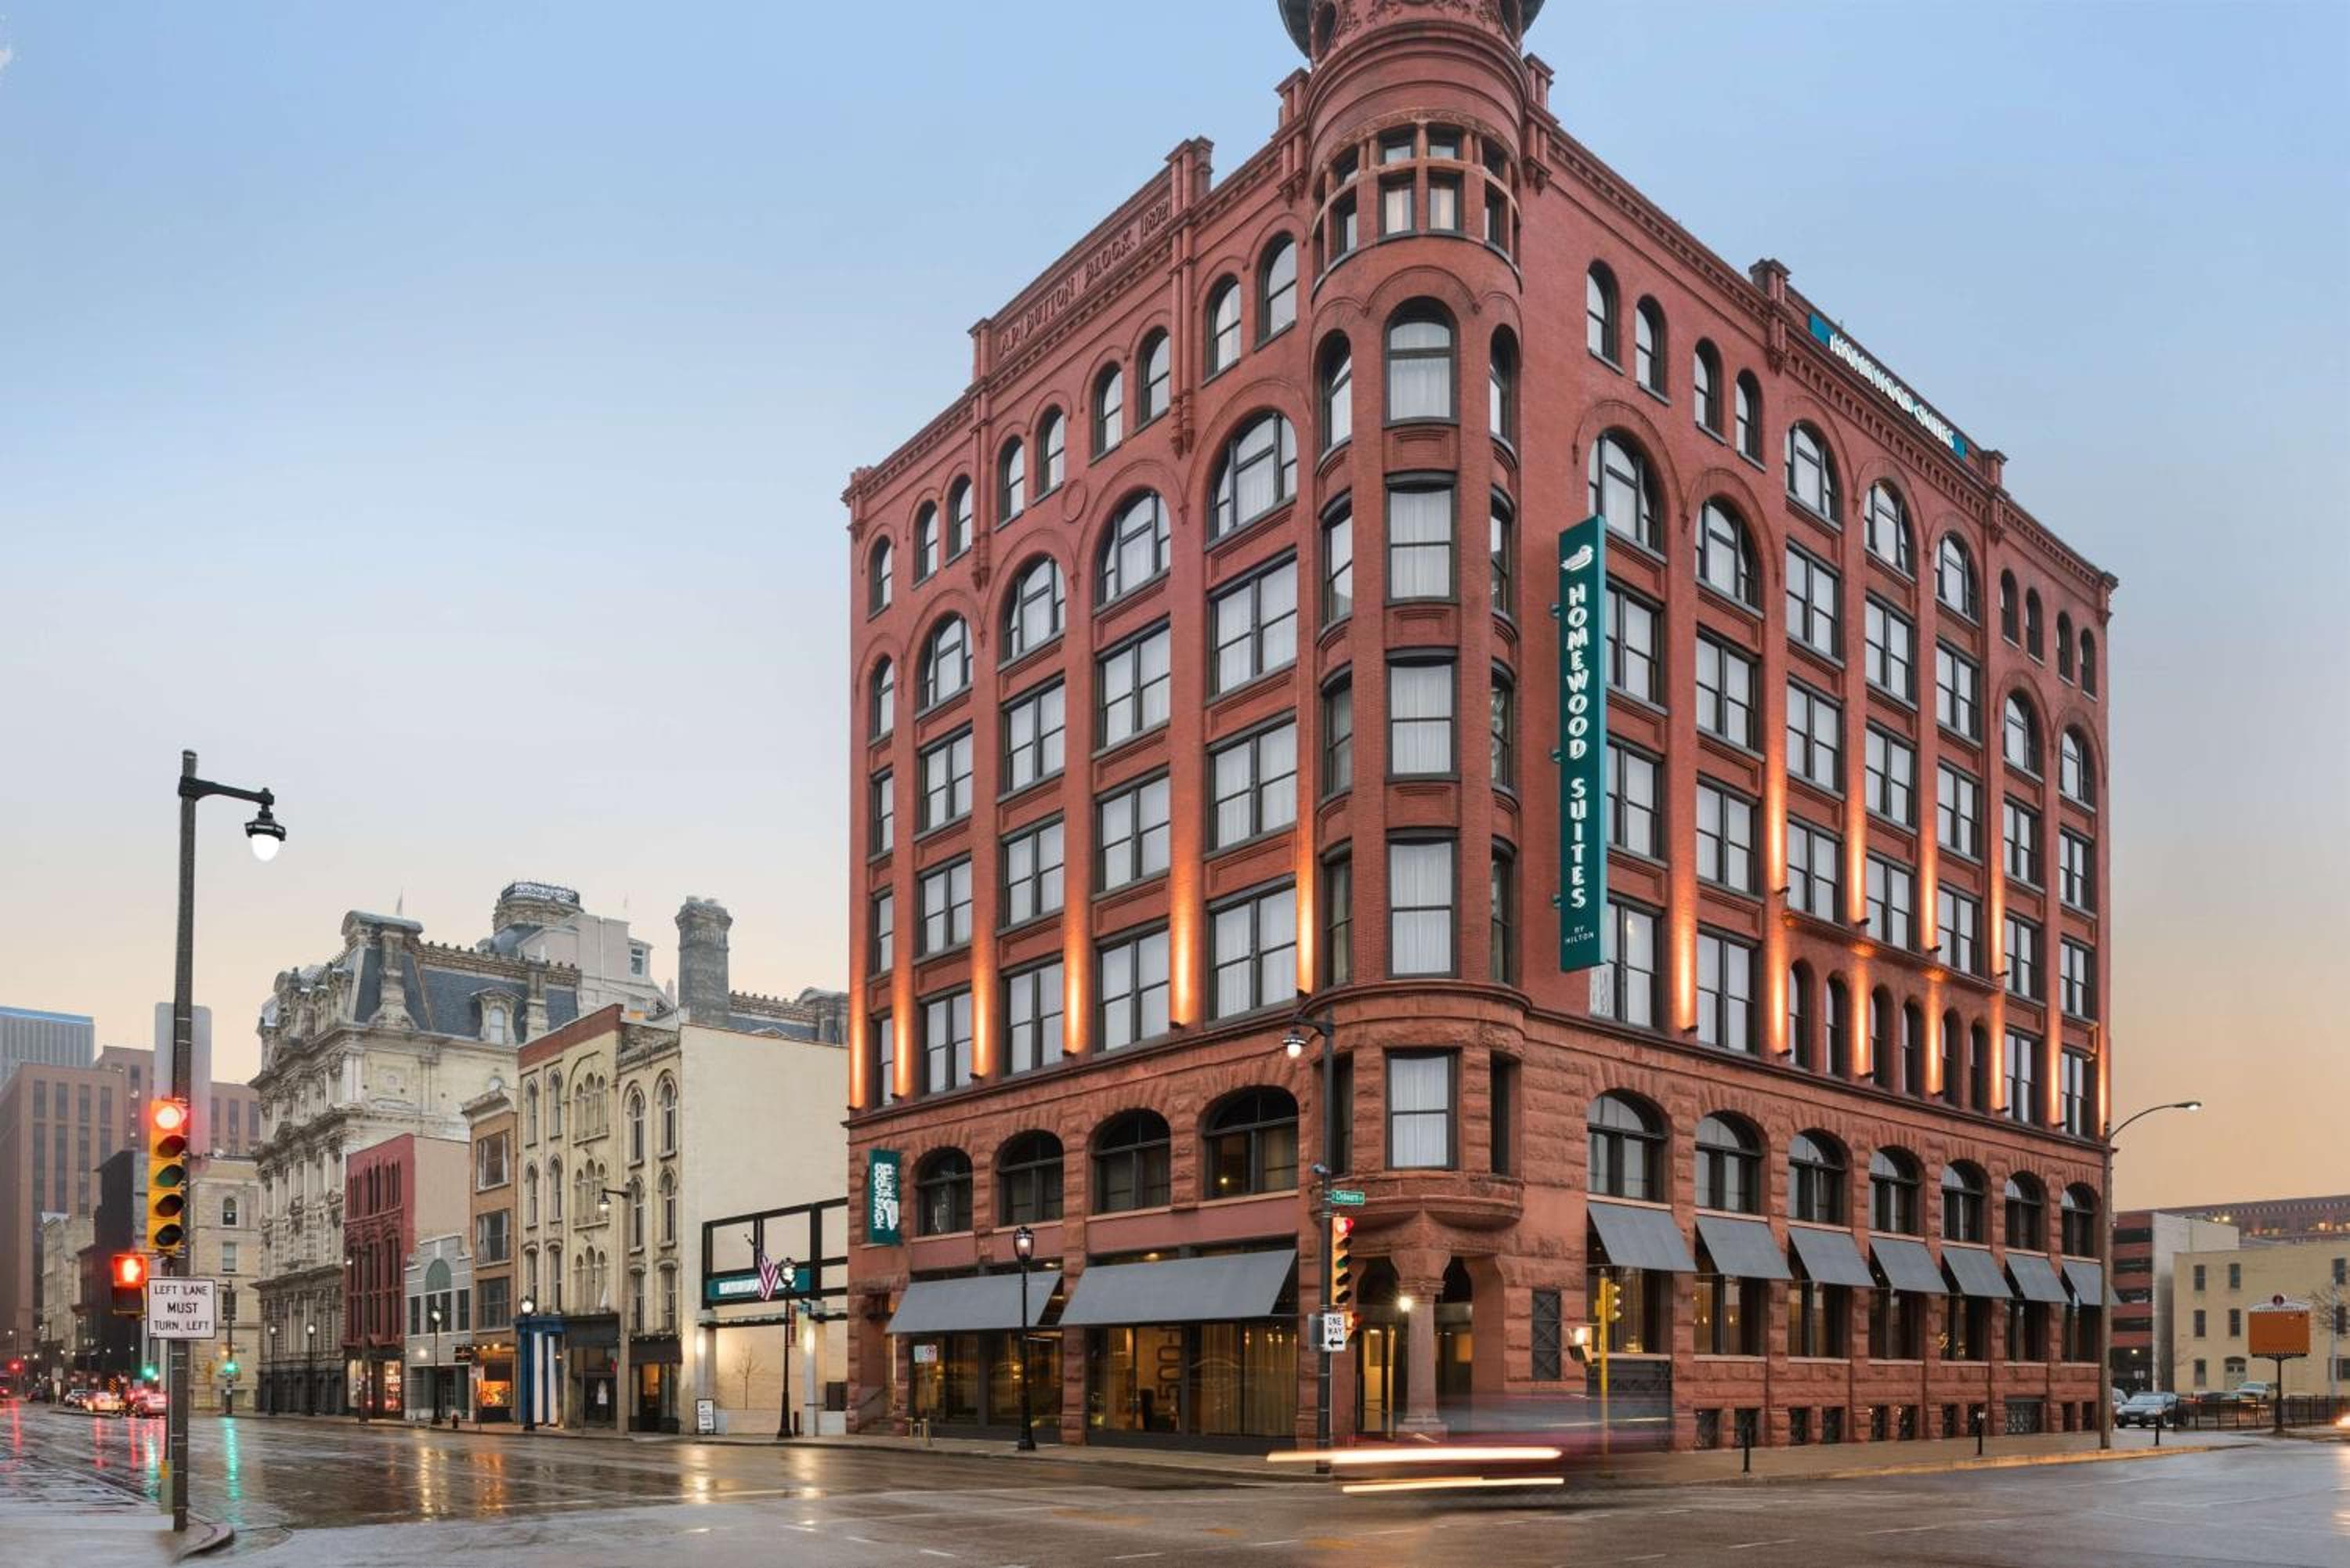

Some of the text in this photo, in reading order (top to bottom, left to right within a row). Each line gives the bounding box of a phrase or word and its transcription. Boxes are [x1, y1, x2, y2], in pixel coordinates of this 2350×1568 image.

[1566, 583, 1589, 909] HOMEWOOD SUITES
[154, 1285, 208, 1295] LEFT LANE
[167, 1302, 198, 1313] MUST
[154, 1320, 208, 1331] TURN LEFT
[1328, 1317, 1342, 1325] ONE
[1328, 1327, 1342, 1335] WAY
